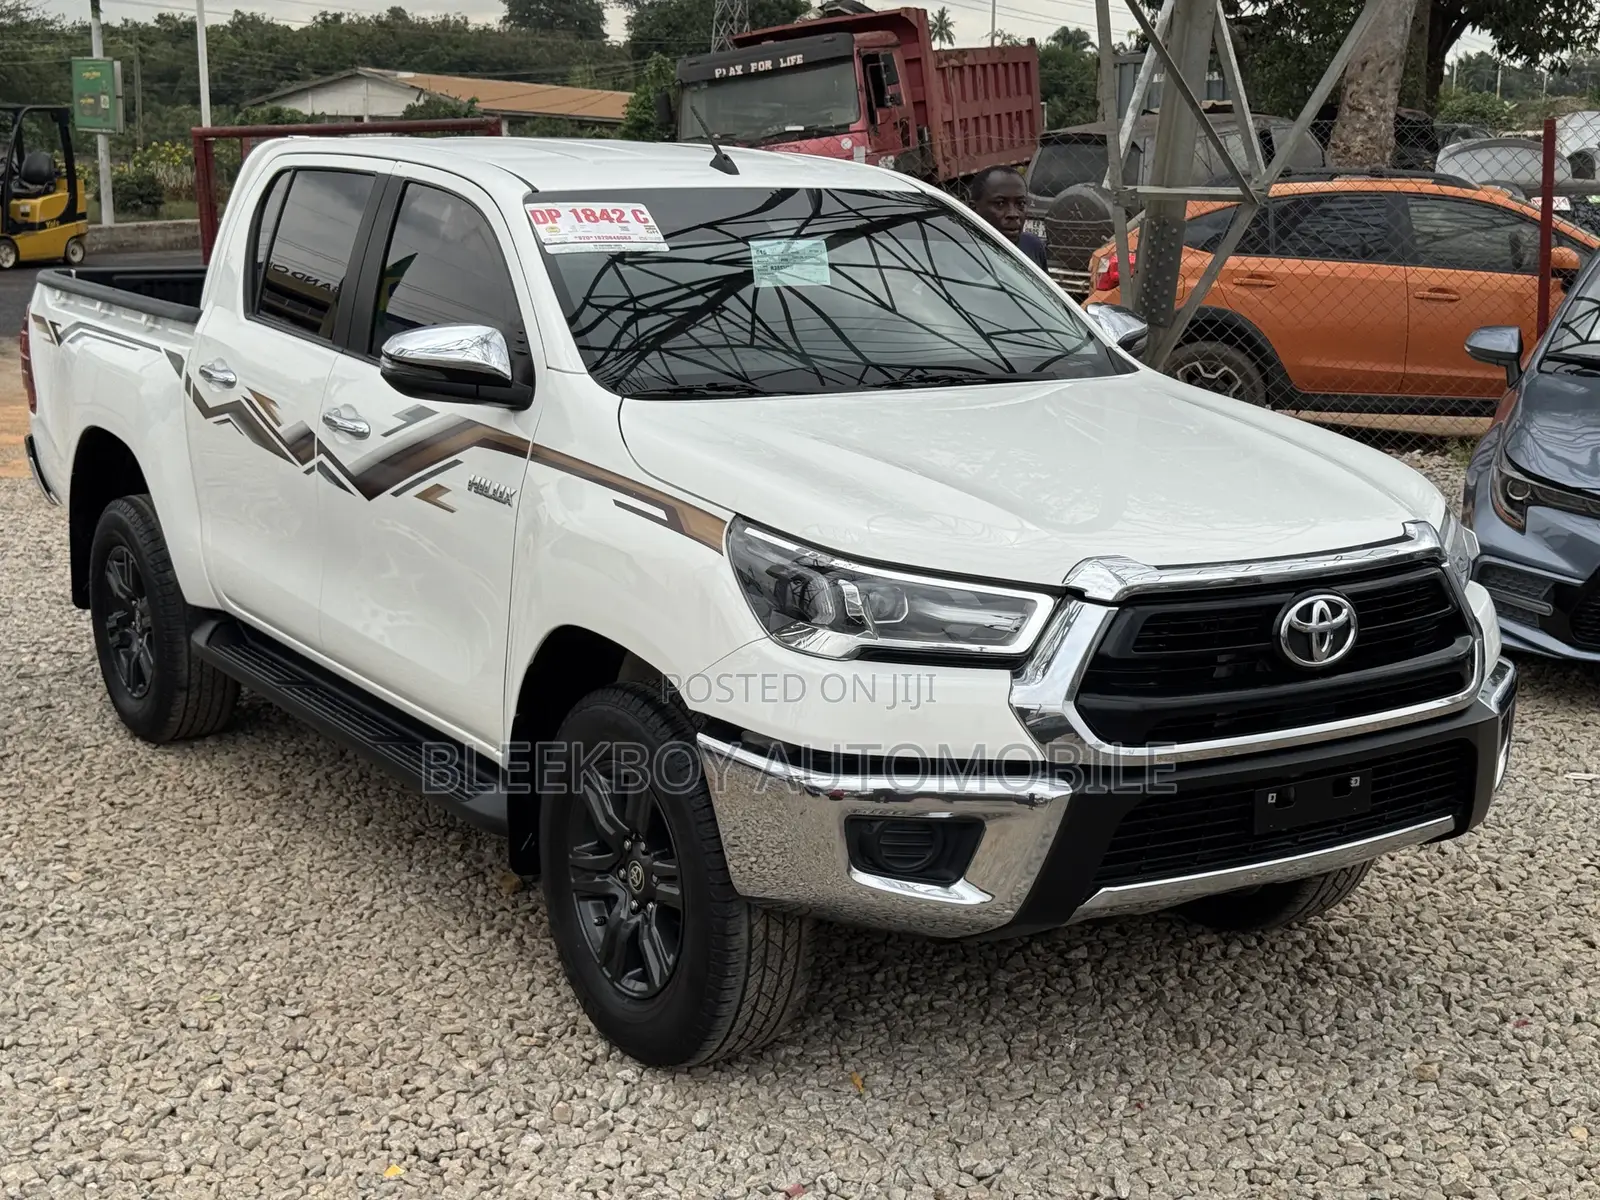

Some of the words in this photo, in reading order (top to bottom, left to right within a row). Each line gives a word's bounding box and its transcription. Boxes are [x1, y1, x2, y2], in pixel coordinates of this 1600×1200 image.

[750, 60, 773, 73] FOR
[779, 54, 804, 68] LIFE
[529, 208, 562, 225] DP
[568, 208, 631, 224] 1842
[631, 208, 650, 224] C
[467, 474, 518, 508] HILUX
